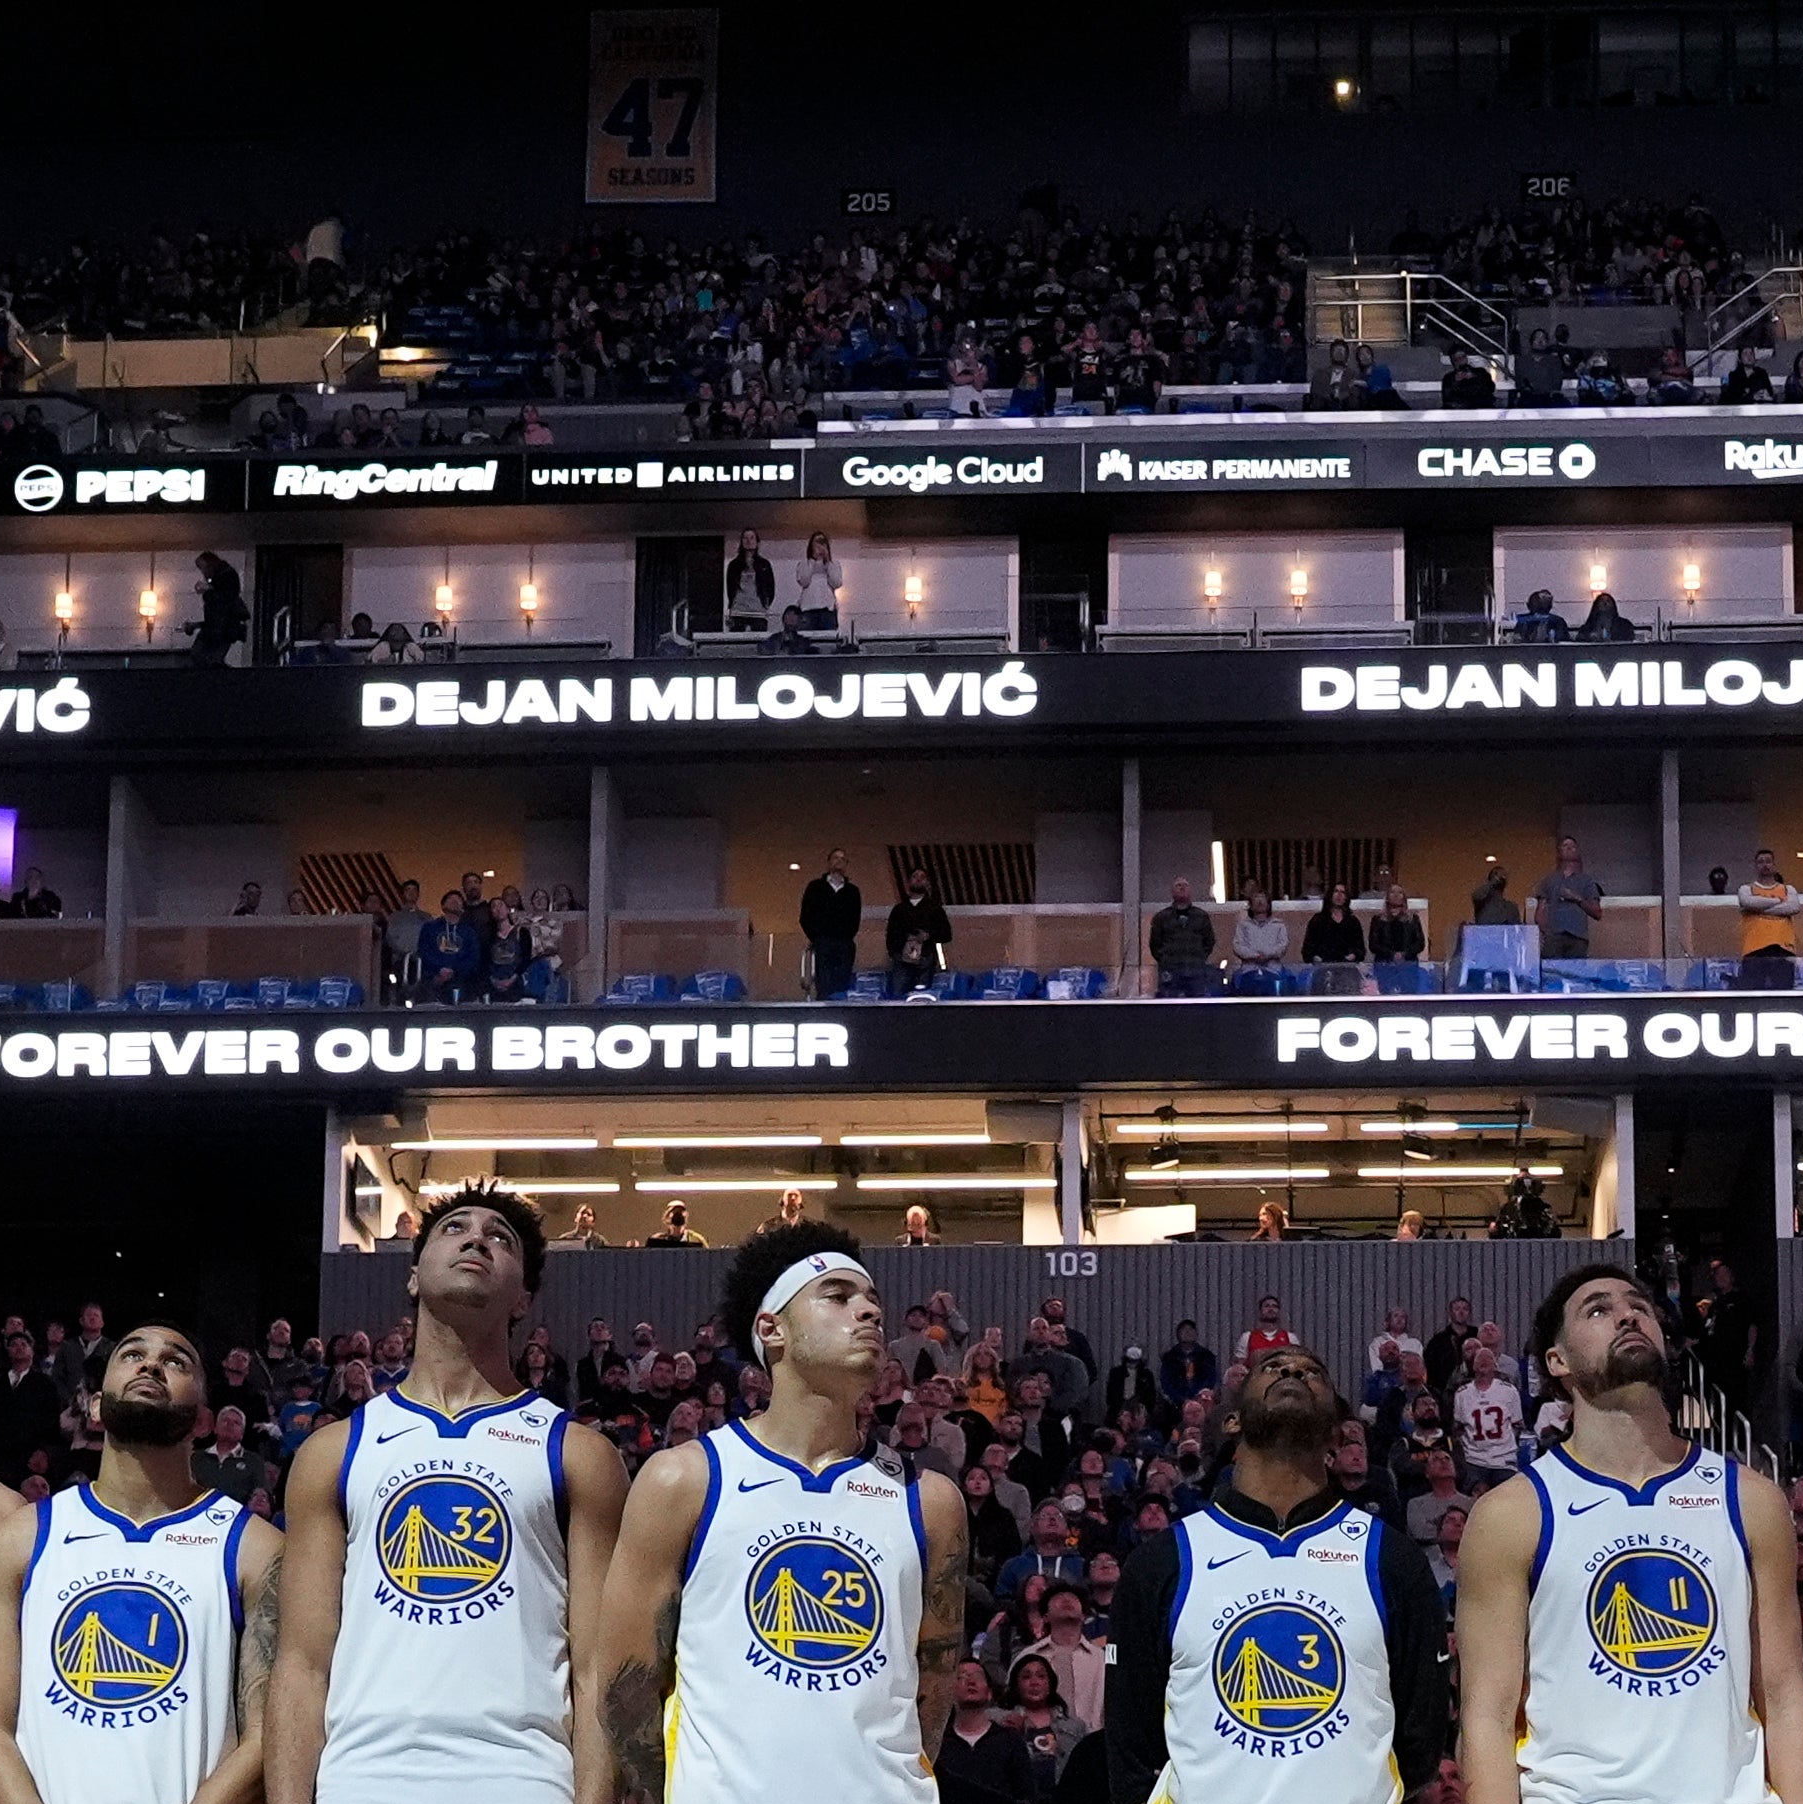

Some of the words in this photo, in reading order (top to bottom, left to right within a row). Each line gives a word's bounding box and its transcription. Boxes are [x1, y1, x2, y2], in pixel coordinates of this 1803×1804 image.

[600, 78, 704, 157] 47
[608, 167, 695, 185] SEASONS
[1527, 177, 1571, 198] 206
[847, 193, 891, 213] 205
[274, 460, 498, 500] RingCentral
[531, 466, 634, 486] UNITED
[667, 463, 795, 483] AIRLINES
[842, 456, 951, 493] Google
[957, 456, 1044, 484] Cloud
[1138, 460, 1208, 482] KAISER
[1212, 457, 1351, 480] PERMANENTE
[1417, 447, 1554, 478] CHASE
[76, 469, 206, 503] PEPSI
[361, 677, 613, 727] DEJAN
[629, 662, 1038, 723] MILOJEVIĆ
[1301, 662, 1557, 712] DEJAN
[314, 1027, 476, 1074] OUR
[491, 1022, 849, 1071] BROTHER
[1277, 1014, 1629, 1063] FOREVER
[1046, 1252, 1098, 1277] 103
[488, 1428, 541, 1447] Rakuten
[1471, 1406, 1504, 1441] 13
[378, 1459, 454, 1500] GOLDEN
[463, 1461, 514, 1500] STATE
[847, 1480, 898, 1499] Rakuten
[1669, 1496, 1720, 1508] Rakuten
[165, 1533, 218, 1546] Rakuten
[450, 1506, 498, 1543] 32
[747, 1521, 823, 1558] GOLDEN
[833, 1525, 884, 1566] STATE
[1307, 1549, 1358, 1562] Rakuten
[1584, 1533, 1650, 1573] GOLDEN
[1660, 1535, 1712, 1569] STATE
[57, 1567, 137, 1603] GOLDEN
[144, 1570, 193, 1606] STATE
[374, 1580, 516, 1625] WARRIORS
[821, 1571, 866, 1608] 25
[1669, 1577, 1687, 1611] 11
[1212, 1587, 1285, 1632] GOLDEN
[1295, 1590, 1346, 1628] STATE
[148, 1613, 160, 1647] 1
[744, 1642, 888, 1692] WARRIORS
[1297, 1635, 1320, 1670] 3
[1587, 1645, 1726, 1697] WARRIORS
[45, 1680, 189, 1729] WARRIORS
[1213, 1709, 1350, 1758] WARRIORS
